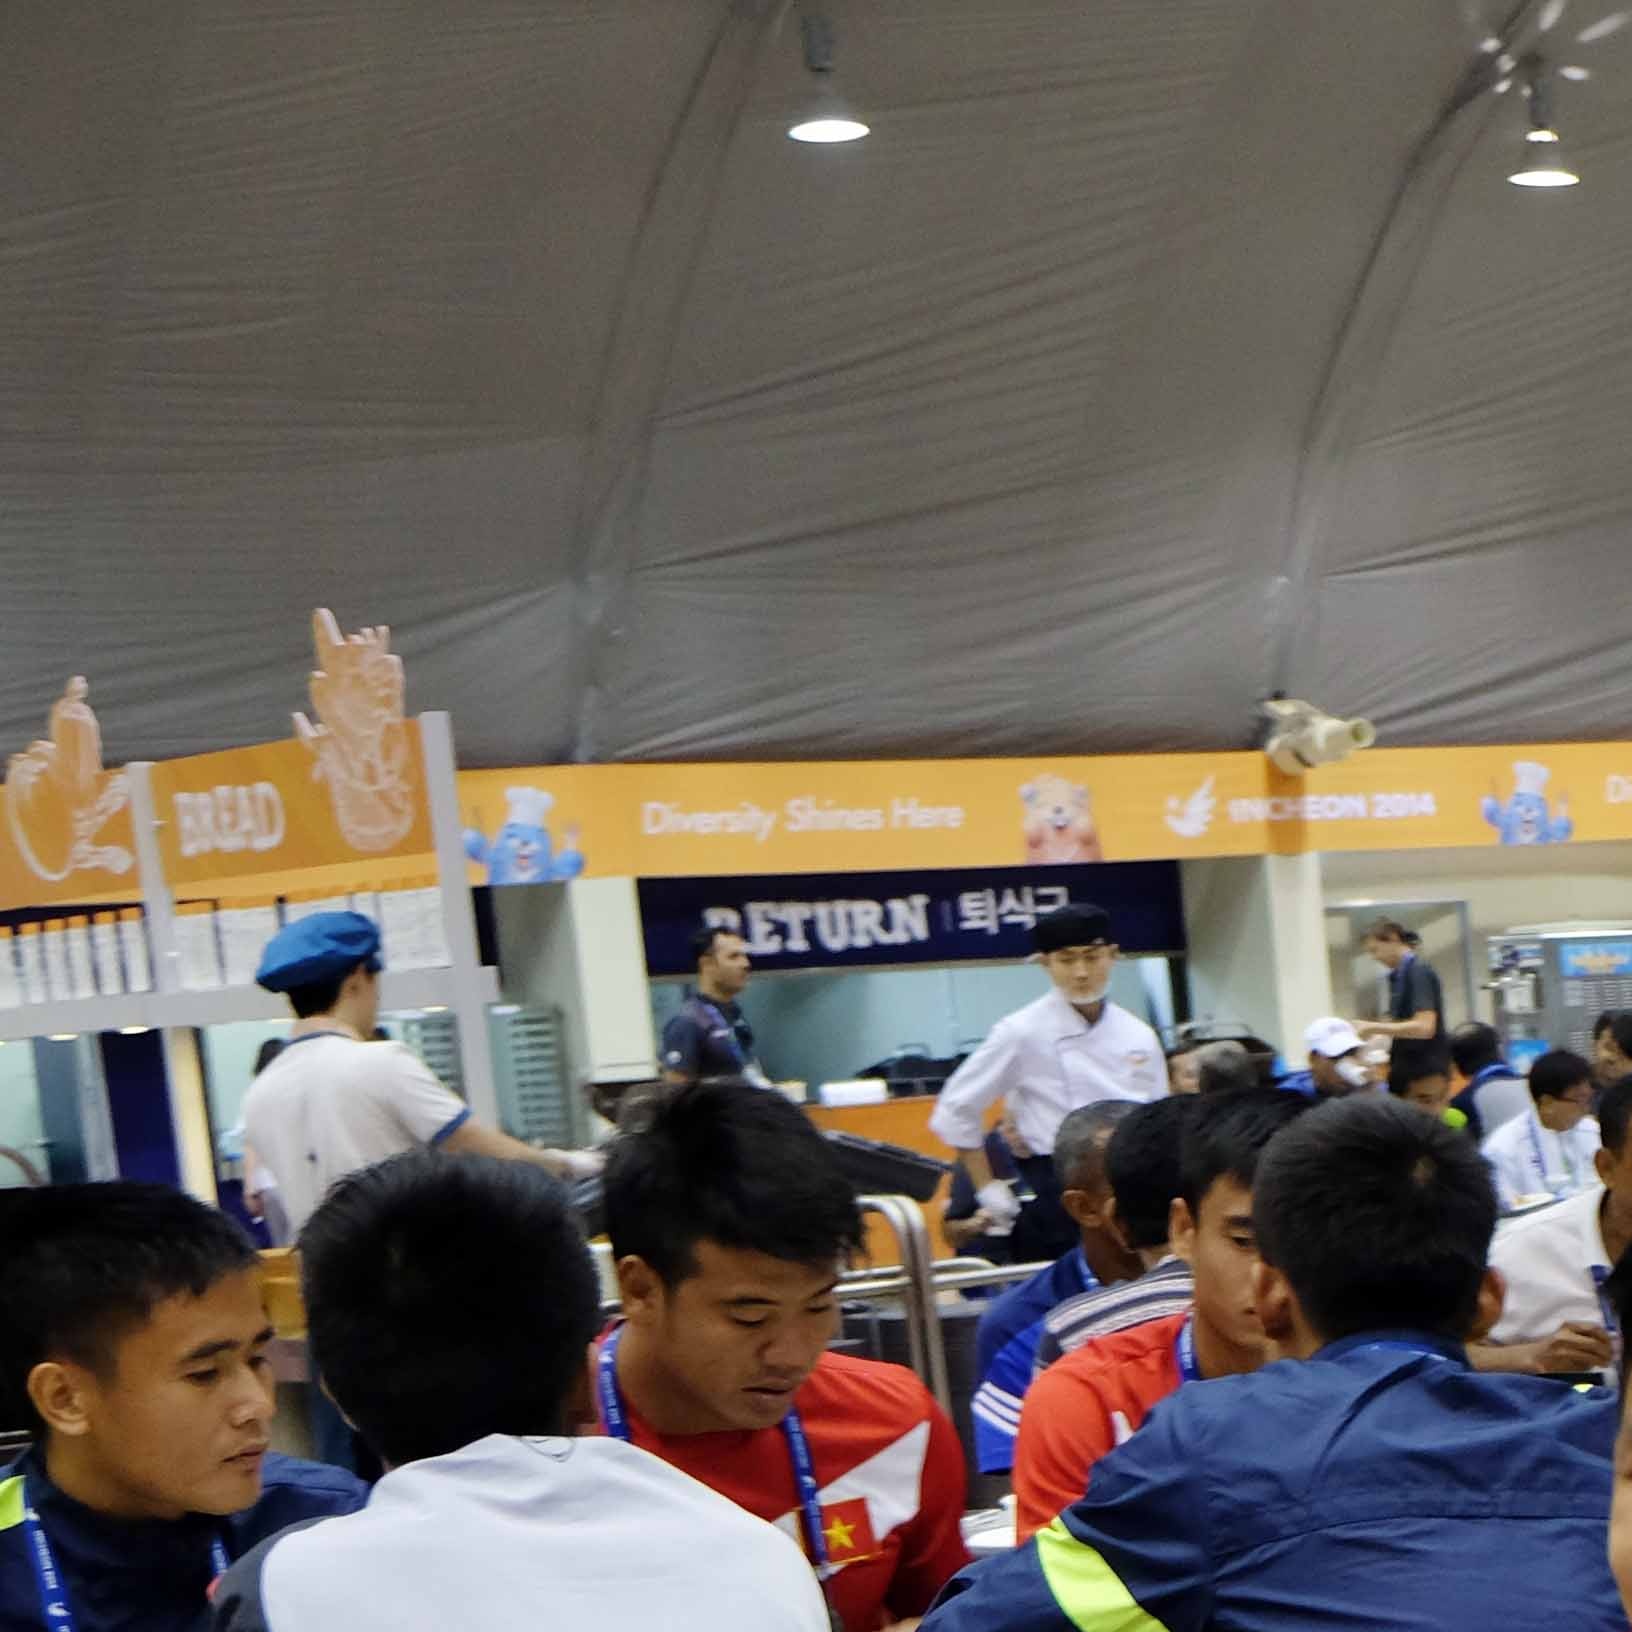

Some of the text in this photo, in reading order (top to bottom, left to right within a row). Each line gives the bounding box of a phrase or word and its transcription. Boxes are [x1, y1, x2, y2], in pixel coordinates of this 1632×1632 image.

[173, 781, 286, 857] BREAD
[643, 797, 965, 840] Diversity Shines Here
